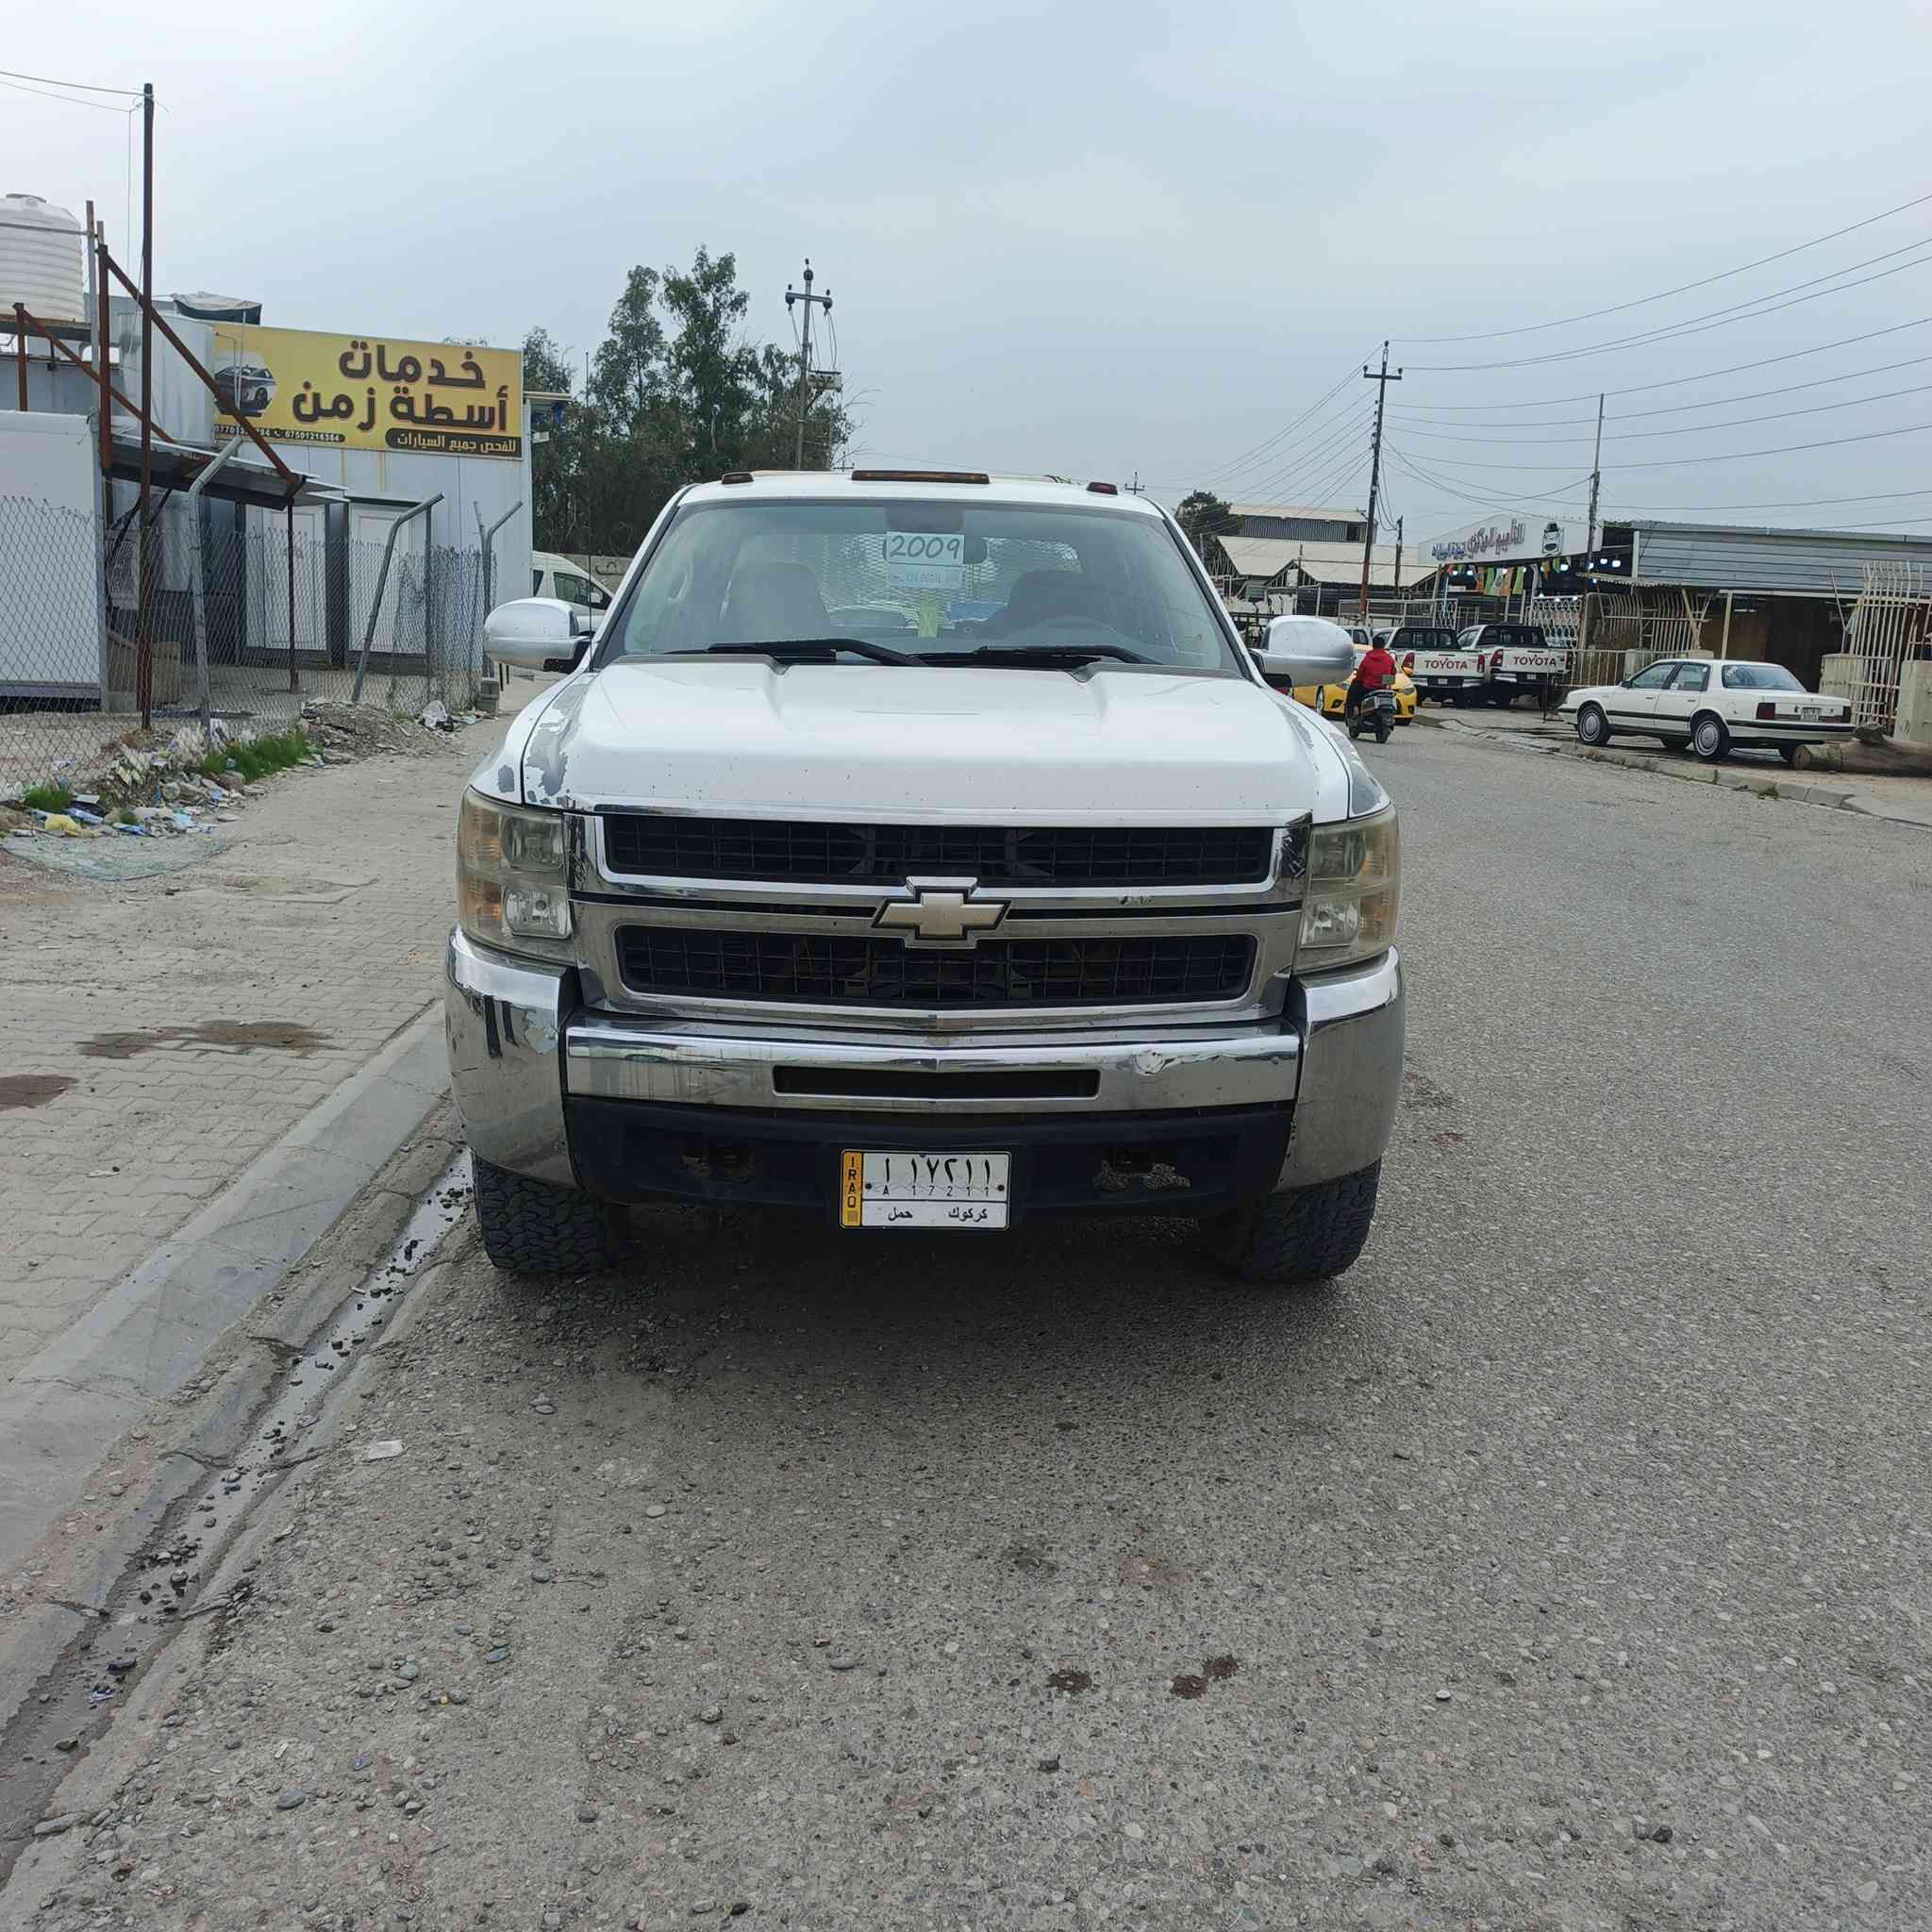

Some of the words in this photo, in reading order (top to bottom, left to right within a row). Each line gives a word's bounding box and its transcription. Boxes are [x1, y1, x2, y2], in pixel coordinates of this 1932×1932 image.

[339, 340, 486, 390] خدمات
[292, 380, 376, 431] زمن
[390, 385, 508, 432] أسطة
[396, 432, 445, 448] السيارات
[448, 439, 476, 452] جميع
[480, 439, 516, 453] للفحص
[890, 534, 960, 559] 2009
[1424, 659, 1468, 670] TOYOTA
[1512, 656, 1557, 666] TOYOTA
[847, 1157, 857, 1208] IRAQ
[888, 1207, 913, 1222] حمل
[948, 1207, 988, 1223] كركوك
